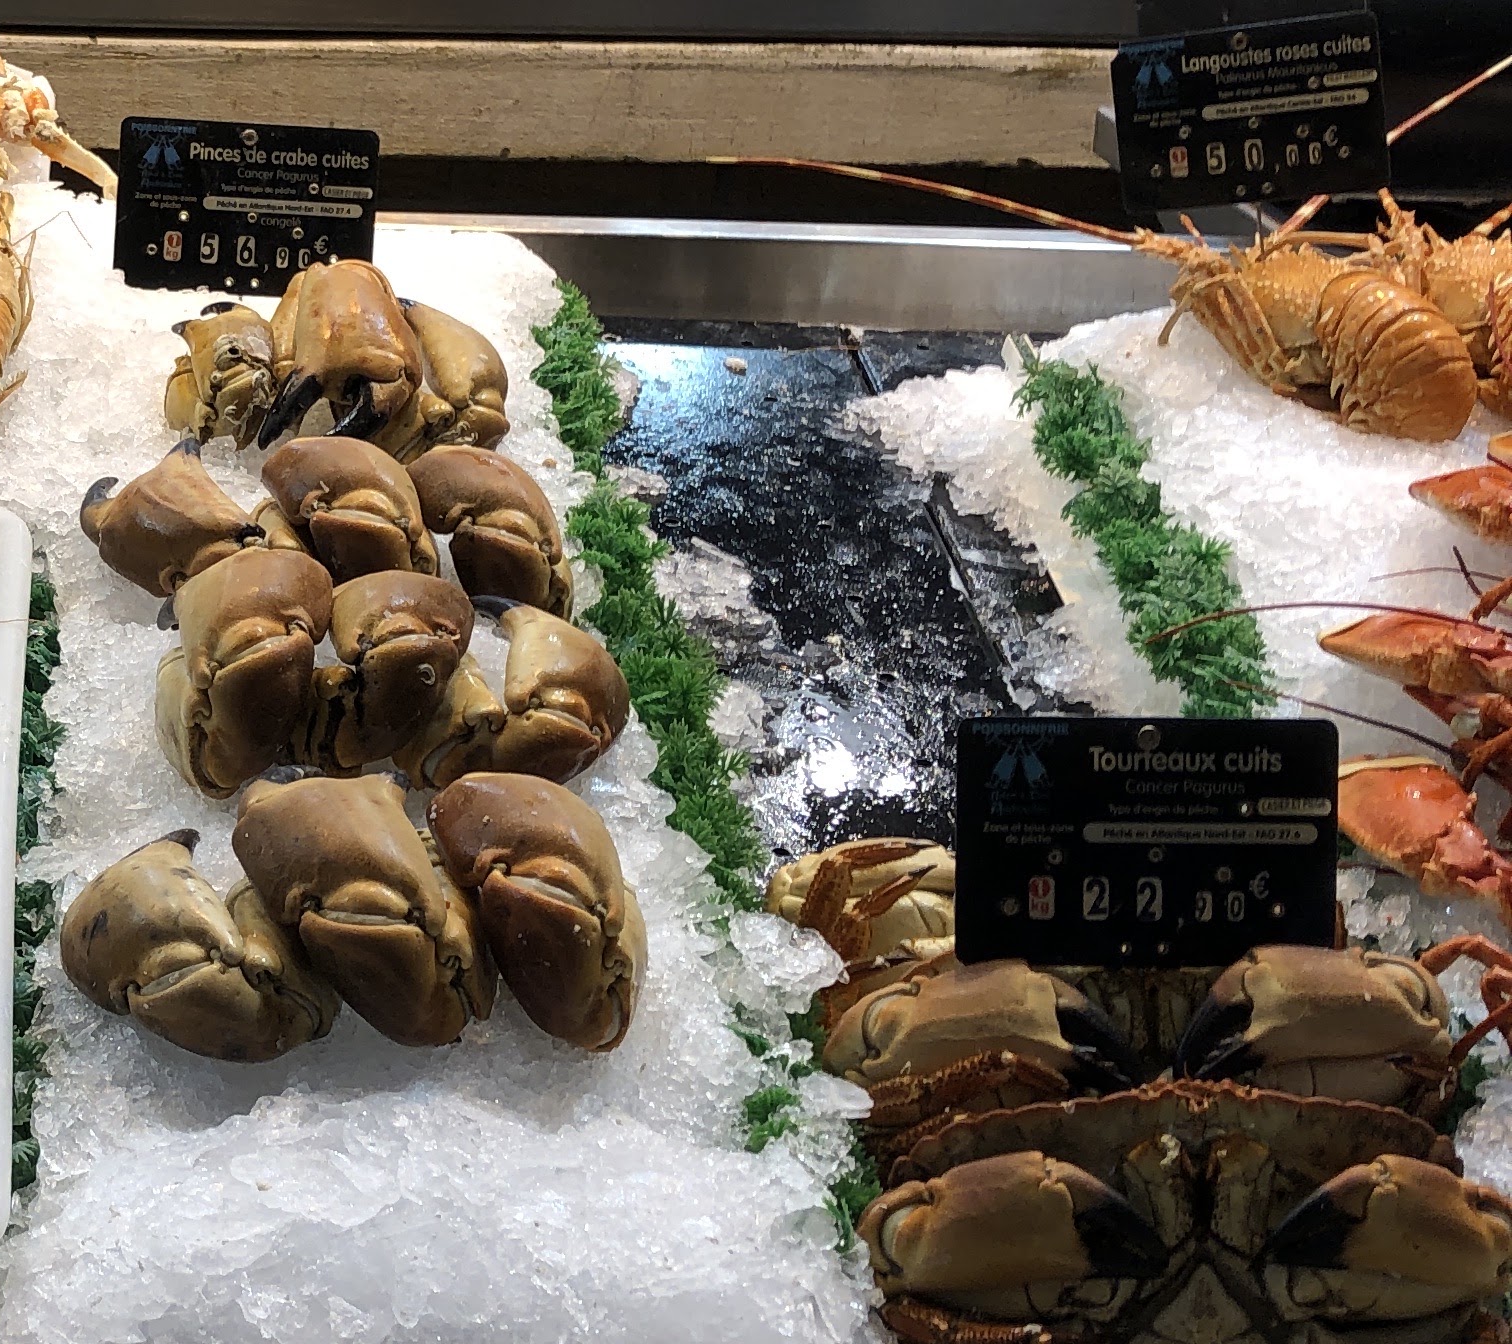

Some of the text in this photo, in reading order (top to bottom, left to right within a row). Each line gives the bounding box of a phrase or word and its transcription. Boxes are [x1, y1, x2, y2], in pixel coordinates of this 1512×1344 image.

[1182, 34, 1371, 73] Langoustes roses cuites
[189, 142, 370, 169] Pinces de crabe cuites
[237, 168, 319, 184] Cancer Pagurus
[1089, 745, 1283, 774] Tourteaux cuits
[1125, 779, 1245, 799] Cancer Pagurus
